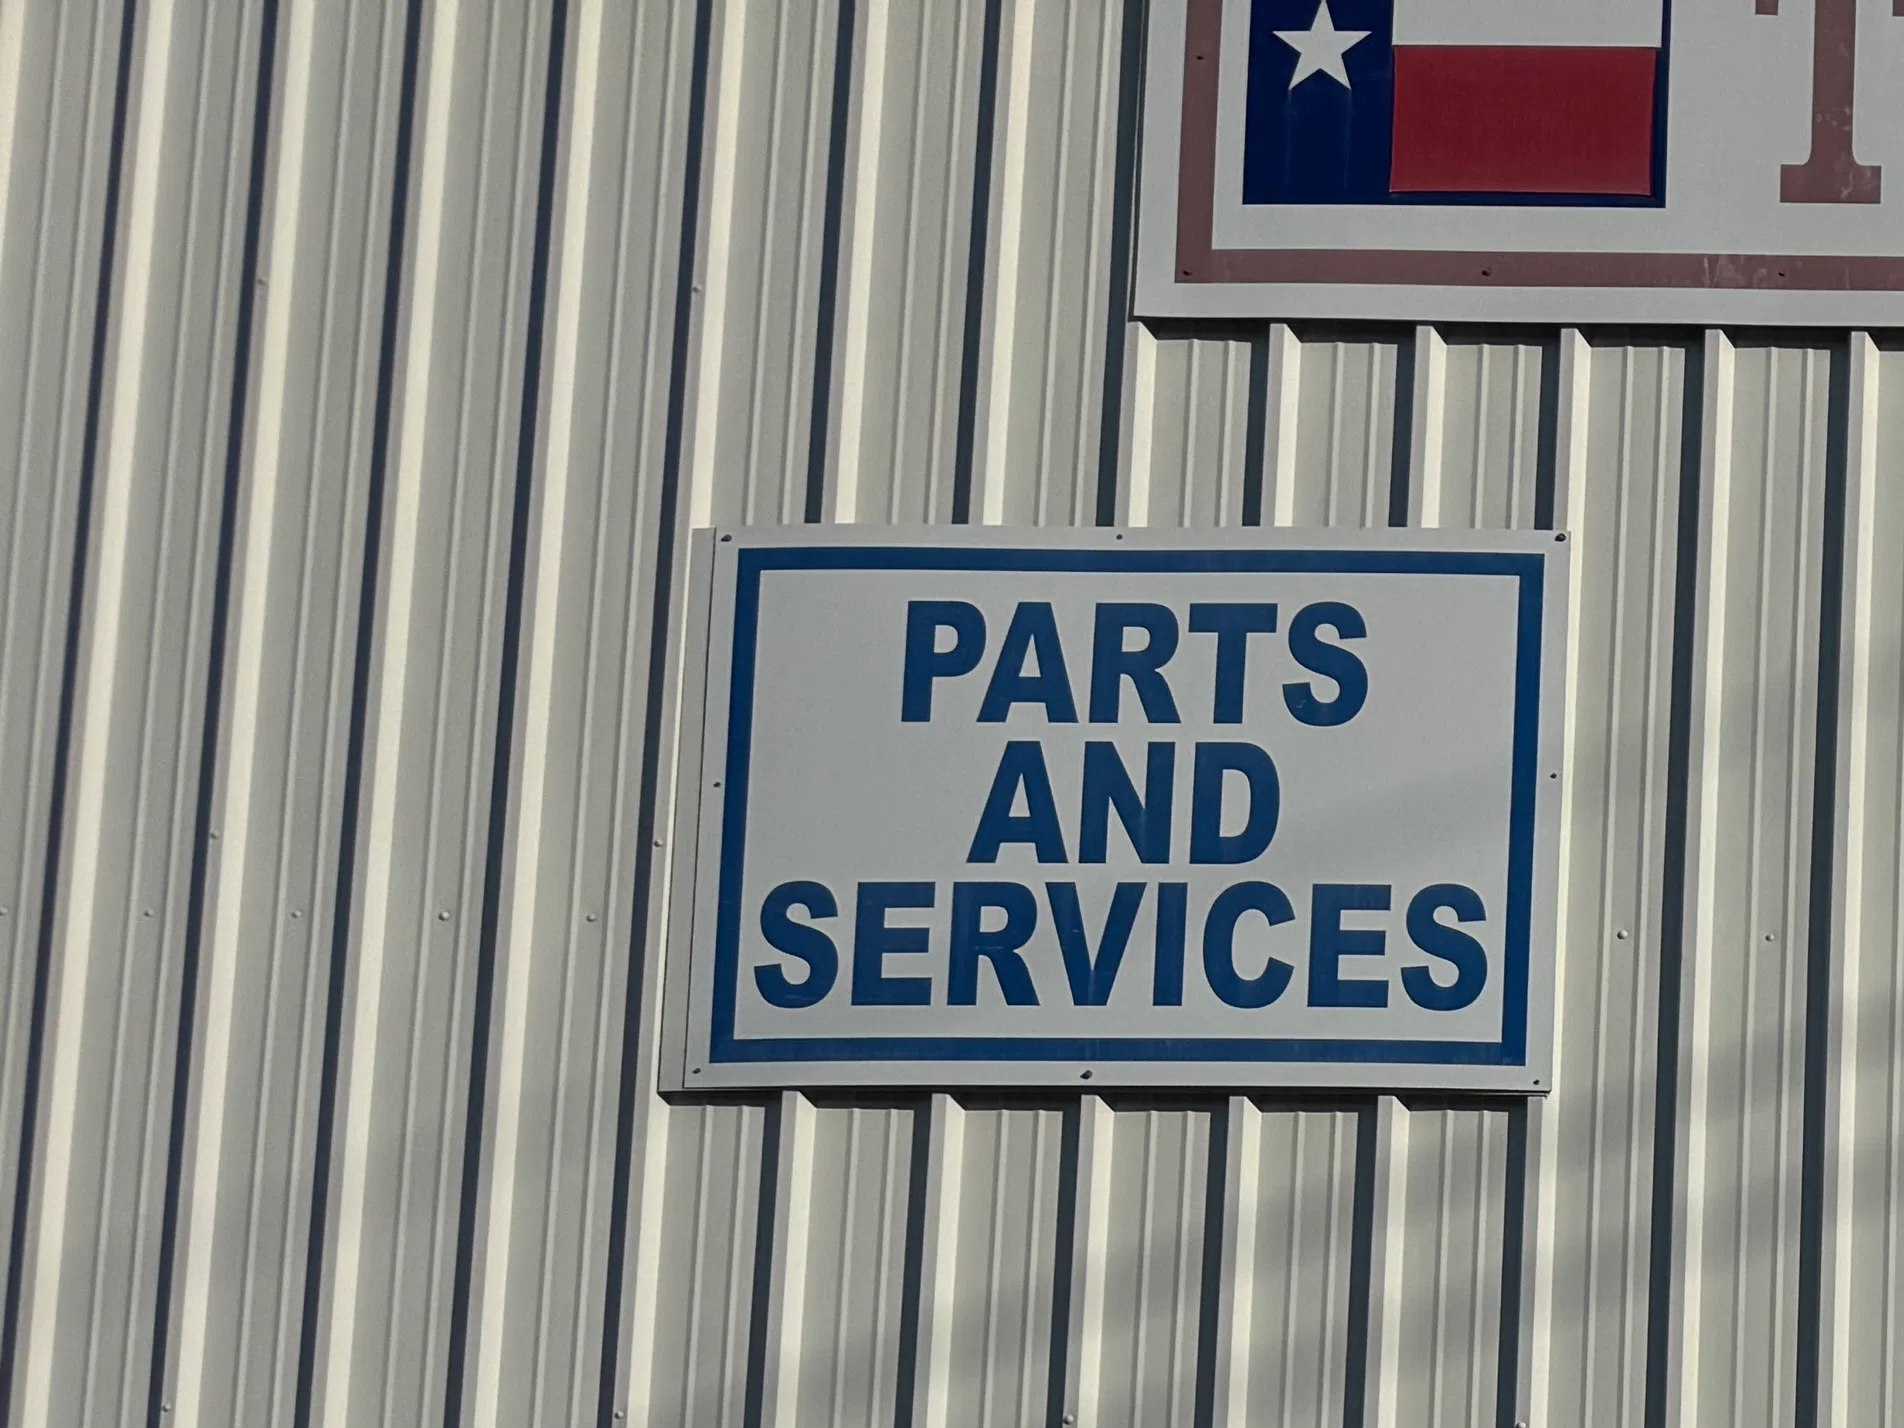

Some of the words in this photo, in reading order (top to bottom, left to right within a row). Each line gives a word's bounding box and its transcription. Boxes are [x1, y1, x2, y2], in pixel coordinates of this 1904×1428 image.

[901, 599, 1369, 728] PARTS
[965, 740, 1281, 866] AND
[752, 880, 1488, 1012] SERVICES
